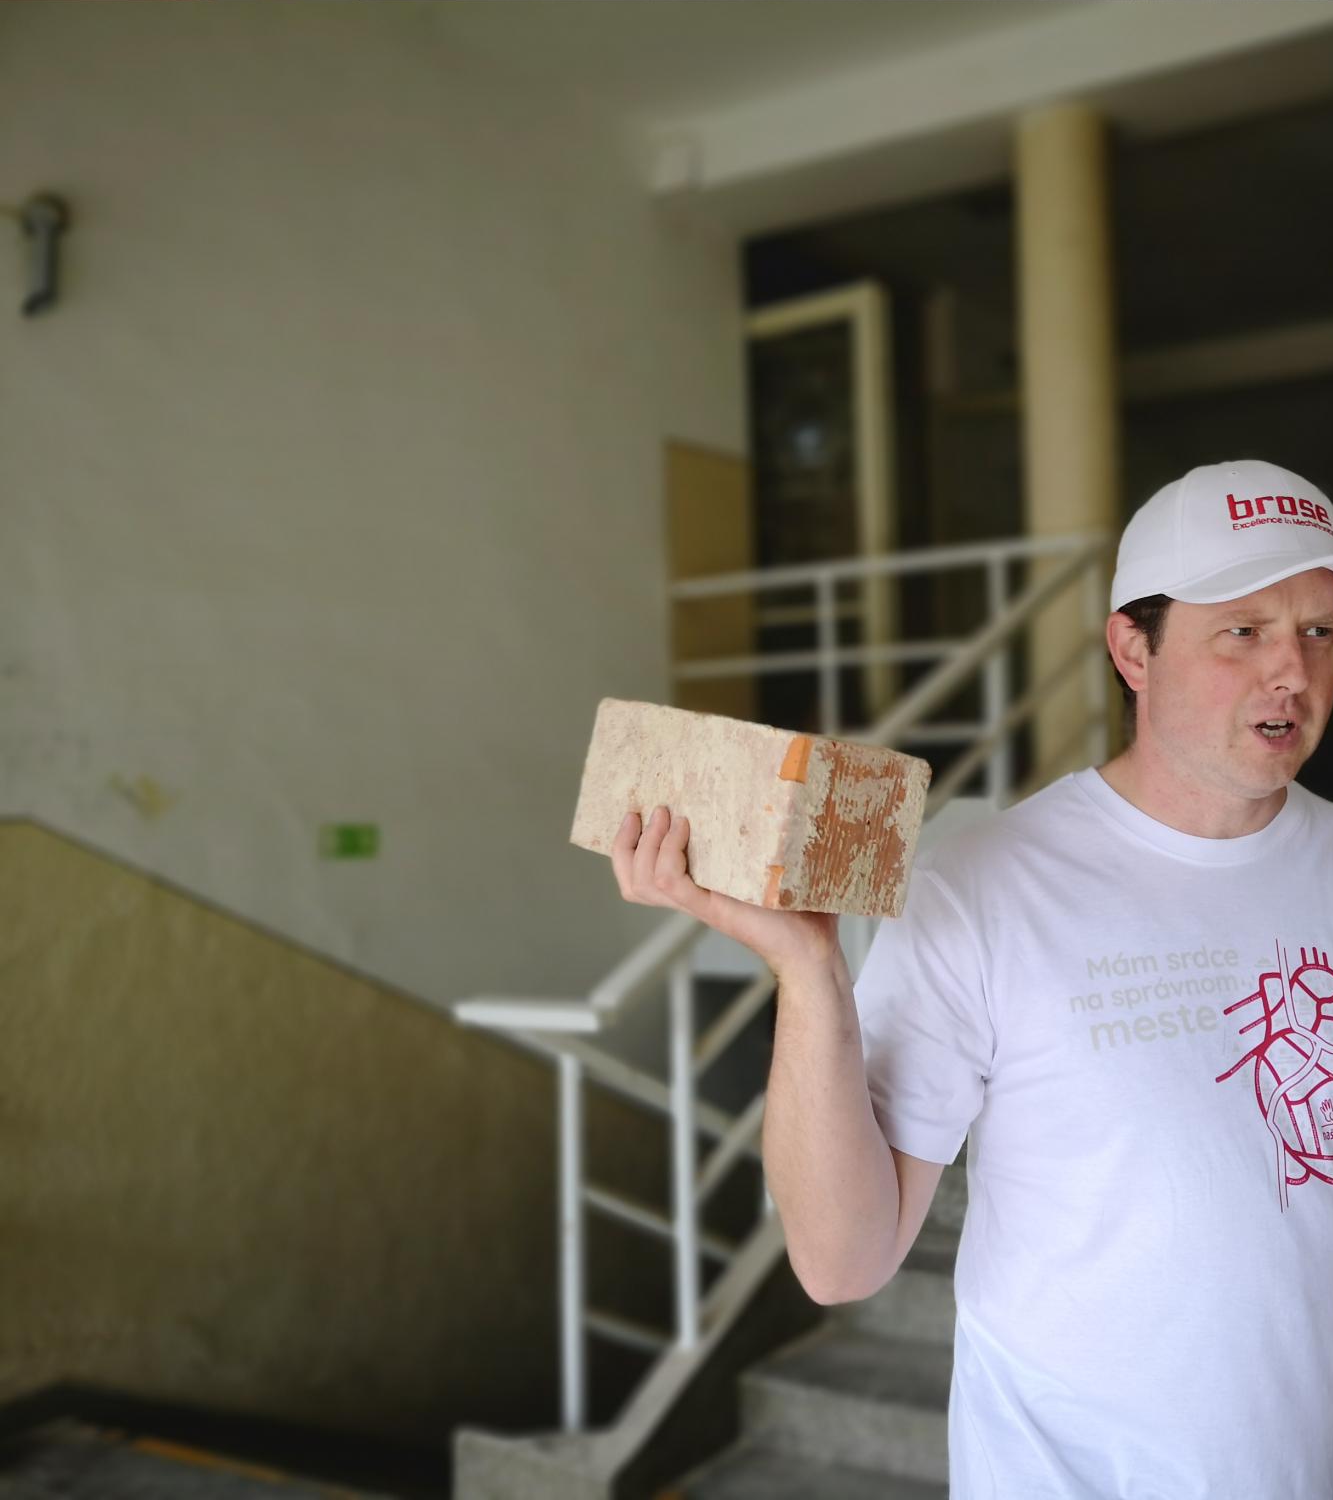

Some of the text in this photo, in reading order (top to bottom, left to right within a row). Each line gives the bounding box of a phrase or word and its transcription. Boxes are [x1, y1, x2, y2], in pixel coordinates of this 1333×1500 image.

[1226, 493, 1332, 527] brose
[1232, 516, 1284, 531] Excellence
[1086, 945, 1239, 980] Mám srdce
[1069, 992, 1104, 1013] na
[1111, 973, 1239, 1009] správnom
[1089, 1002, 1219, 1051] meste
